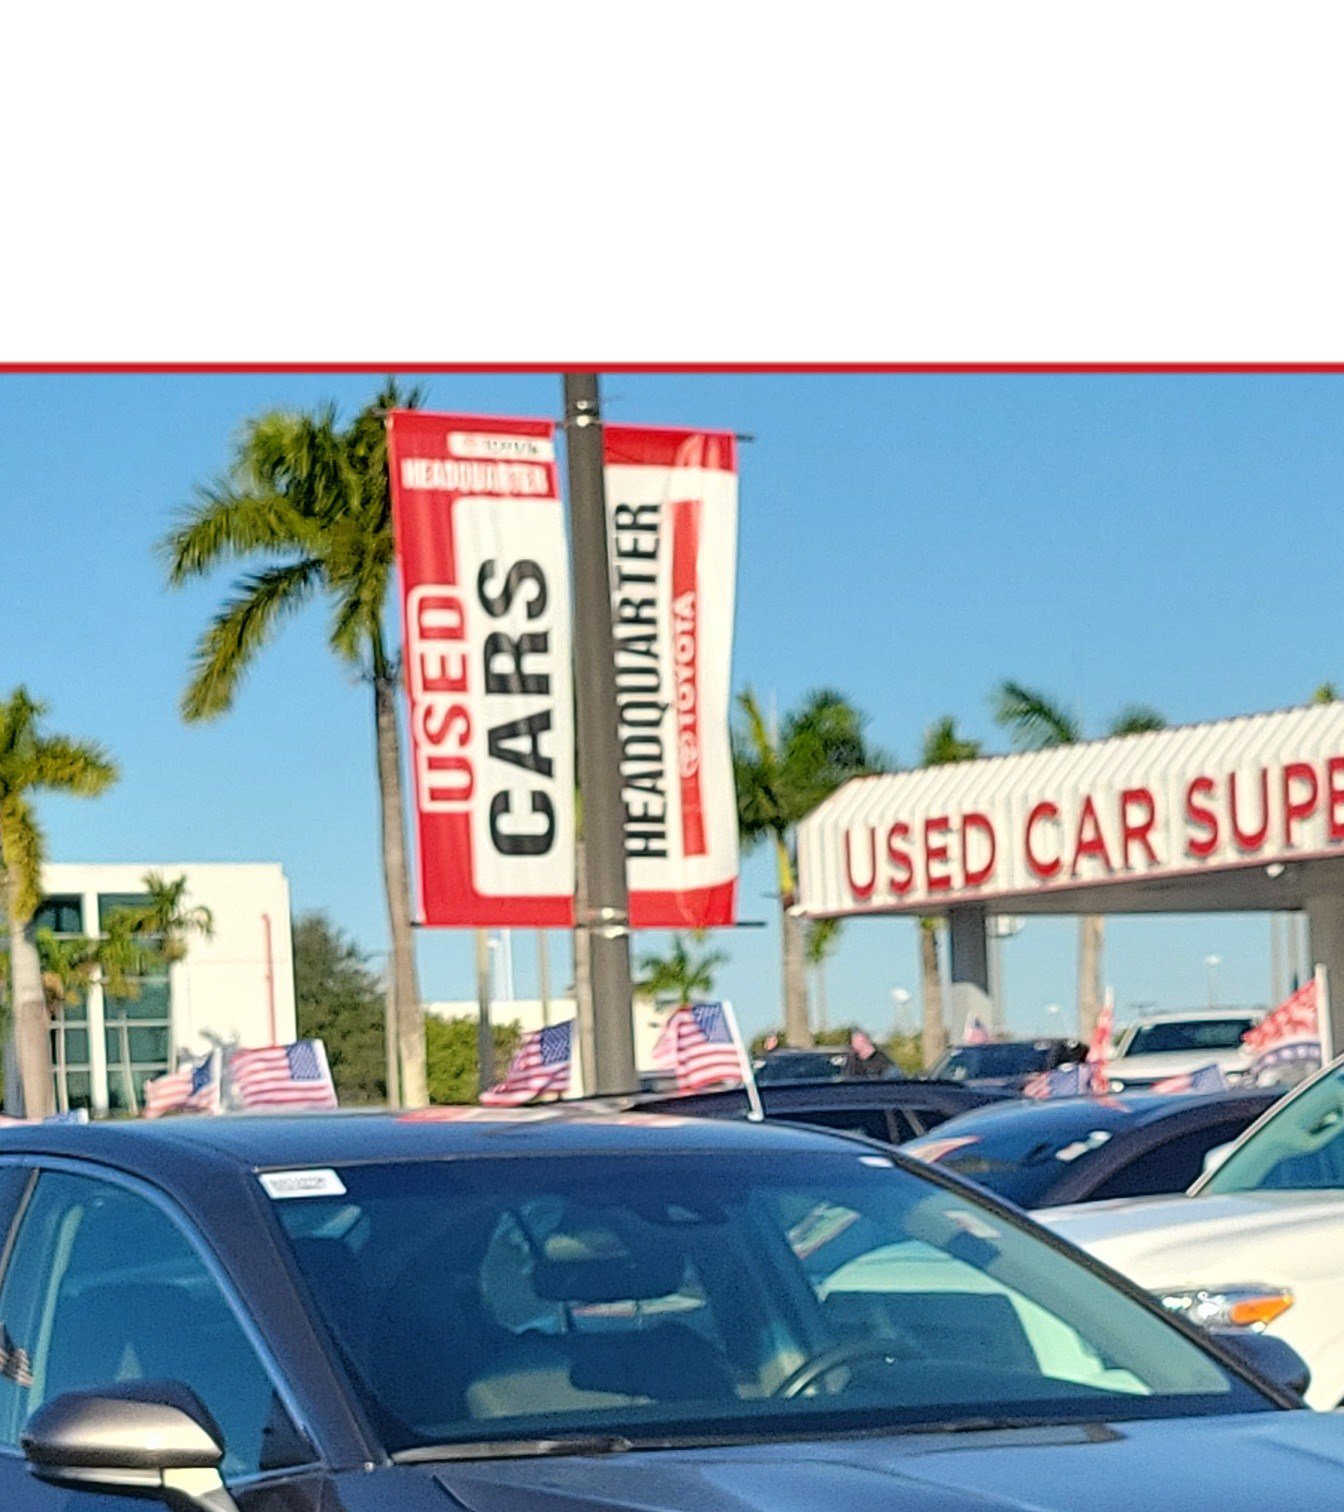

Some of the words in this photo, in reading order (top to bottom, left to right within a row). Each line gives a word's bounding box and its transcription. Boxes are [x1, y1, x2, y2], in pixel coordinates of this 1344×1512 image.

[417, 596, 475, 802] USED
[476, 558, 557, 858] CARS
[614, 502, 671, 859] HEADQUARTER
[673, 590, 698, 728] TOYOTA
[844, 808, 998, 901] USED
[1024, 787, 1162, 879] CAR
